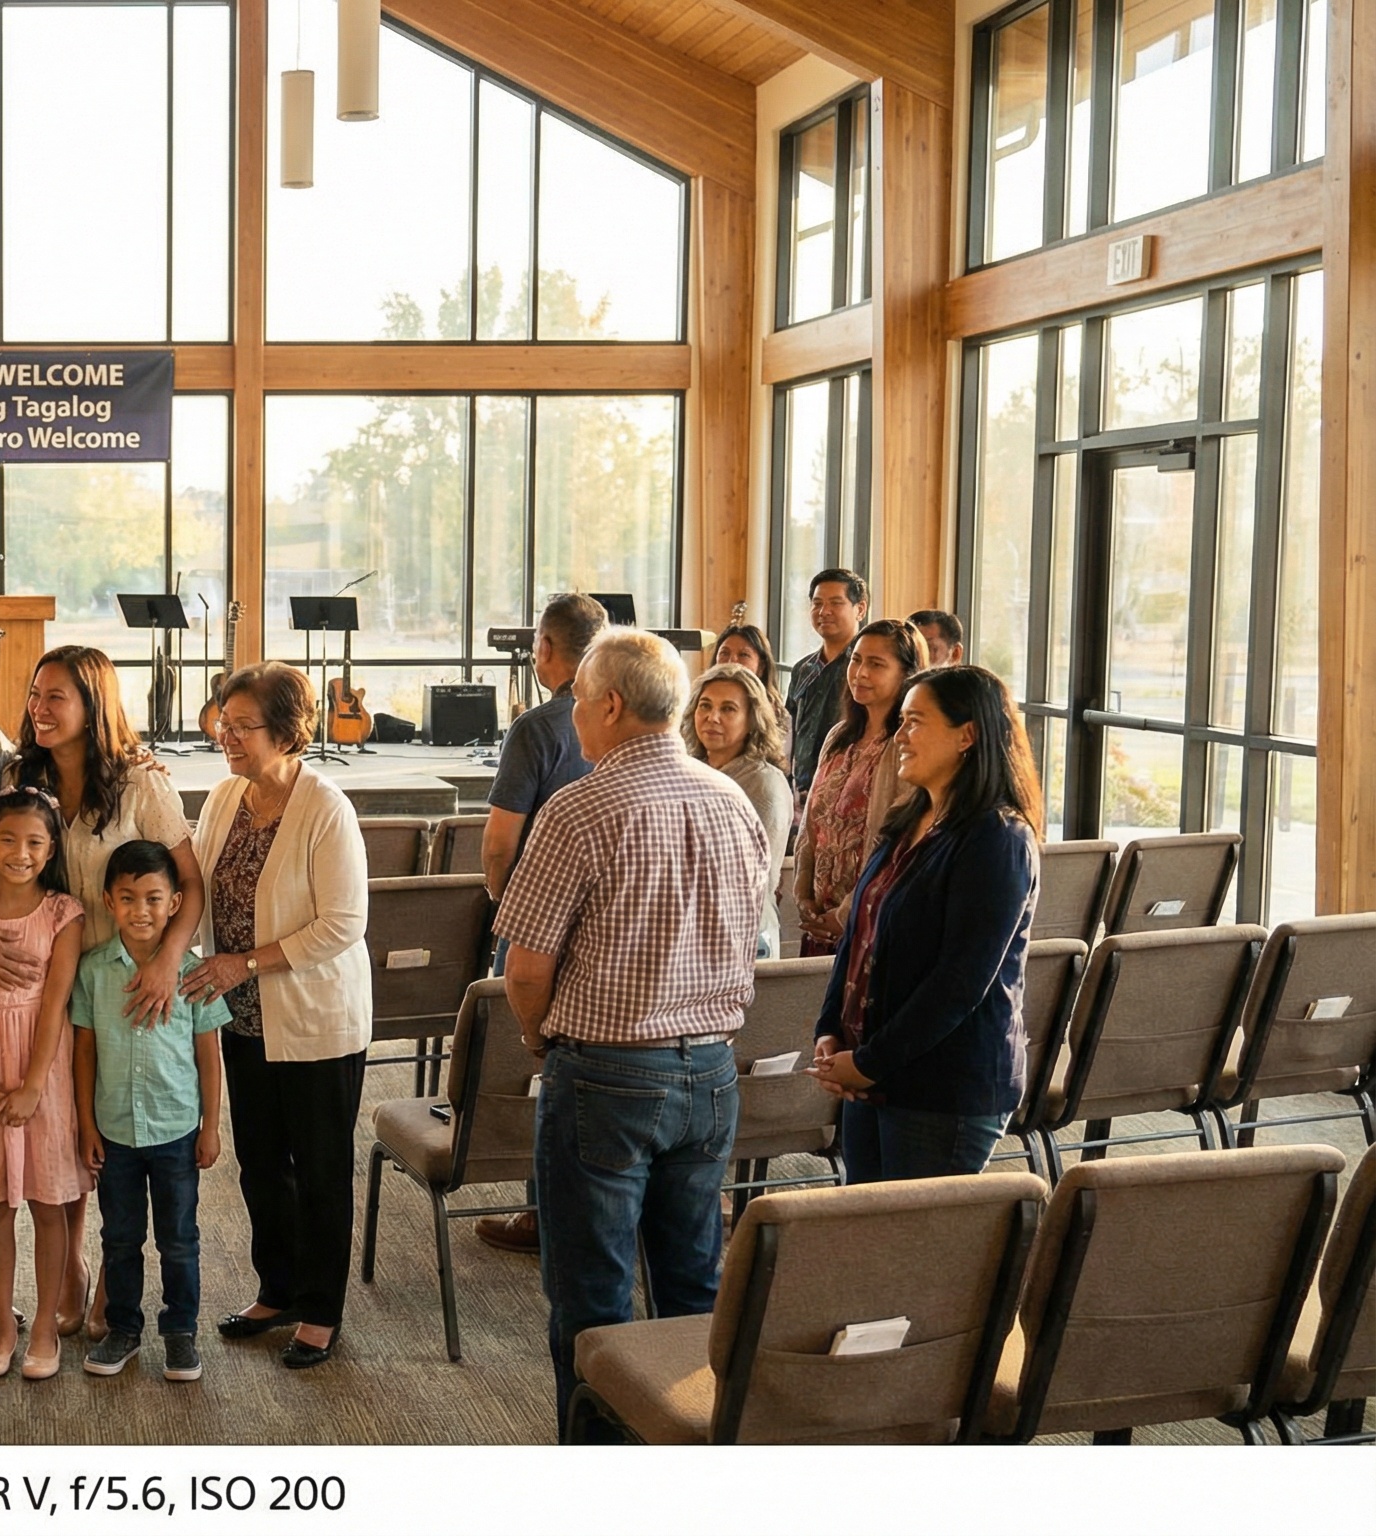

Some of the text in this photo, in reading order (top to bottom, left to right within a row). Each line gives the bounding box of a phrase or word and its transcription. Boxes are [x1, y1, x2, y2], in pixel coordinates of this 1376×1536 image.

[1113, 240, 1139, 281] EXIT
[12, 395, 112, 423] Tagalog
[27, 425, 141, 450] Welcome
